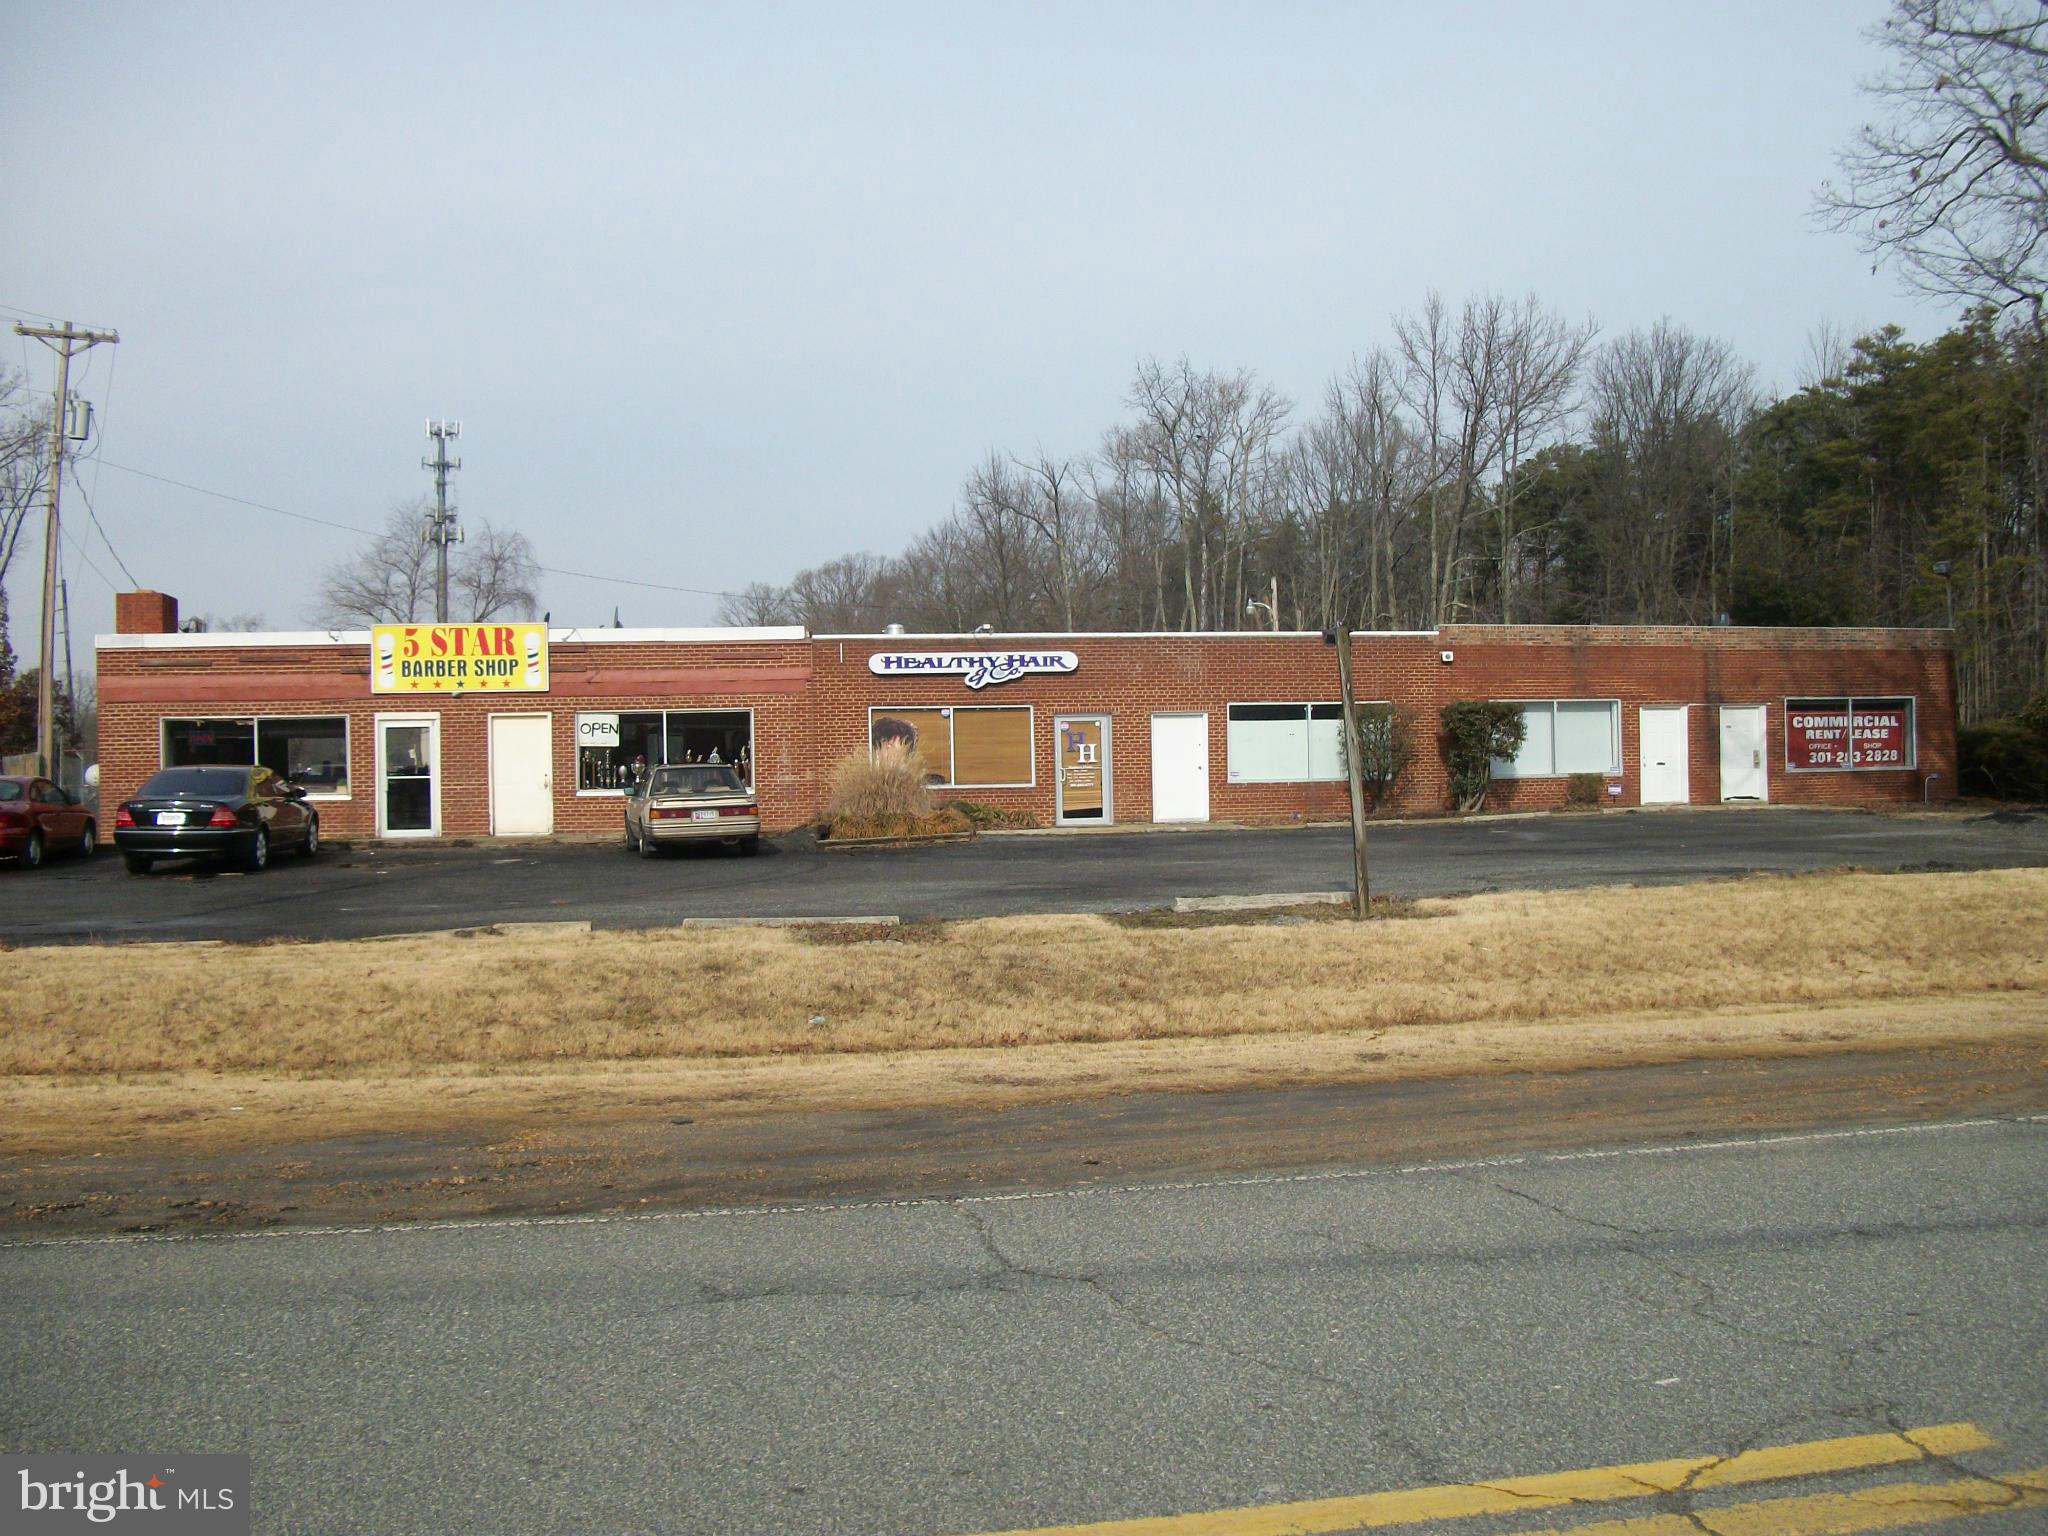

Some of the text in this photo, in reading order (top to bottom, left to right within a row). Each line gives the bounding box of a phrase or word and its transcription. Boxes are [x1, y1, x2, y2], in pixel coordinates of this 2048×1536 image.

[403, 627, 517, 657] 5 STAR
[401, 658, 519, 678] BARBER SHOP
[1004, 654, 1071, 669] HAIR
[580, 722, 620, 737] OPEN
[1805, 728, 1889, 740] RENT/EASE
[1077, 743, 1099, 763] H
